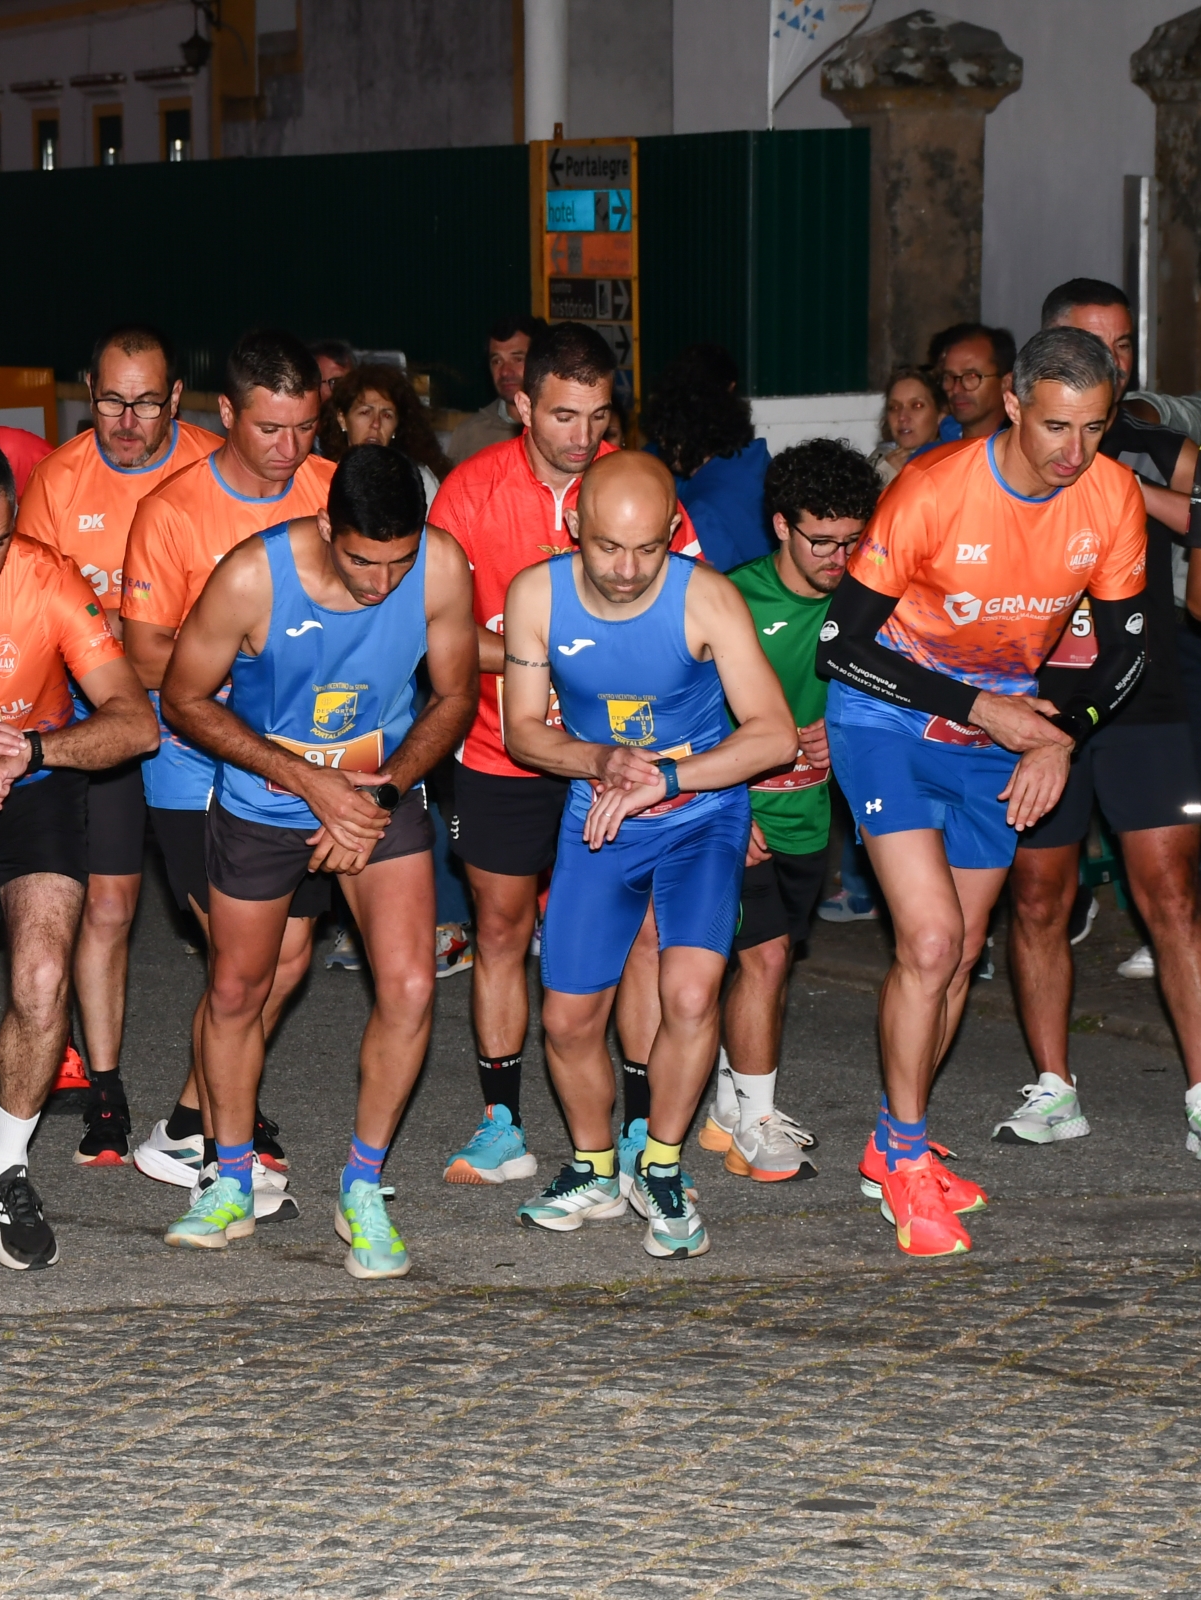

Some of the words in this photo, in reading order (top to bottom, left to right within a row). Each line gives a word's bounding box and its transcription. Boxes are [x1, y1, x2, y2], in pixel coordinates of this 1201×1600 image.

[565, 156, 629, 181] Portalegre
[548, 200, 576, 223] hotel
[78, 513, 105, 530] DK
[956, 543, 991, 561] DK
[303, 747, 347, 769] 97
